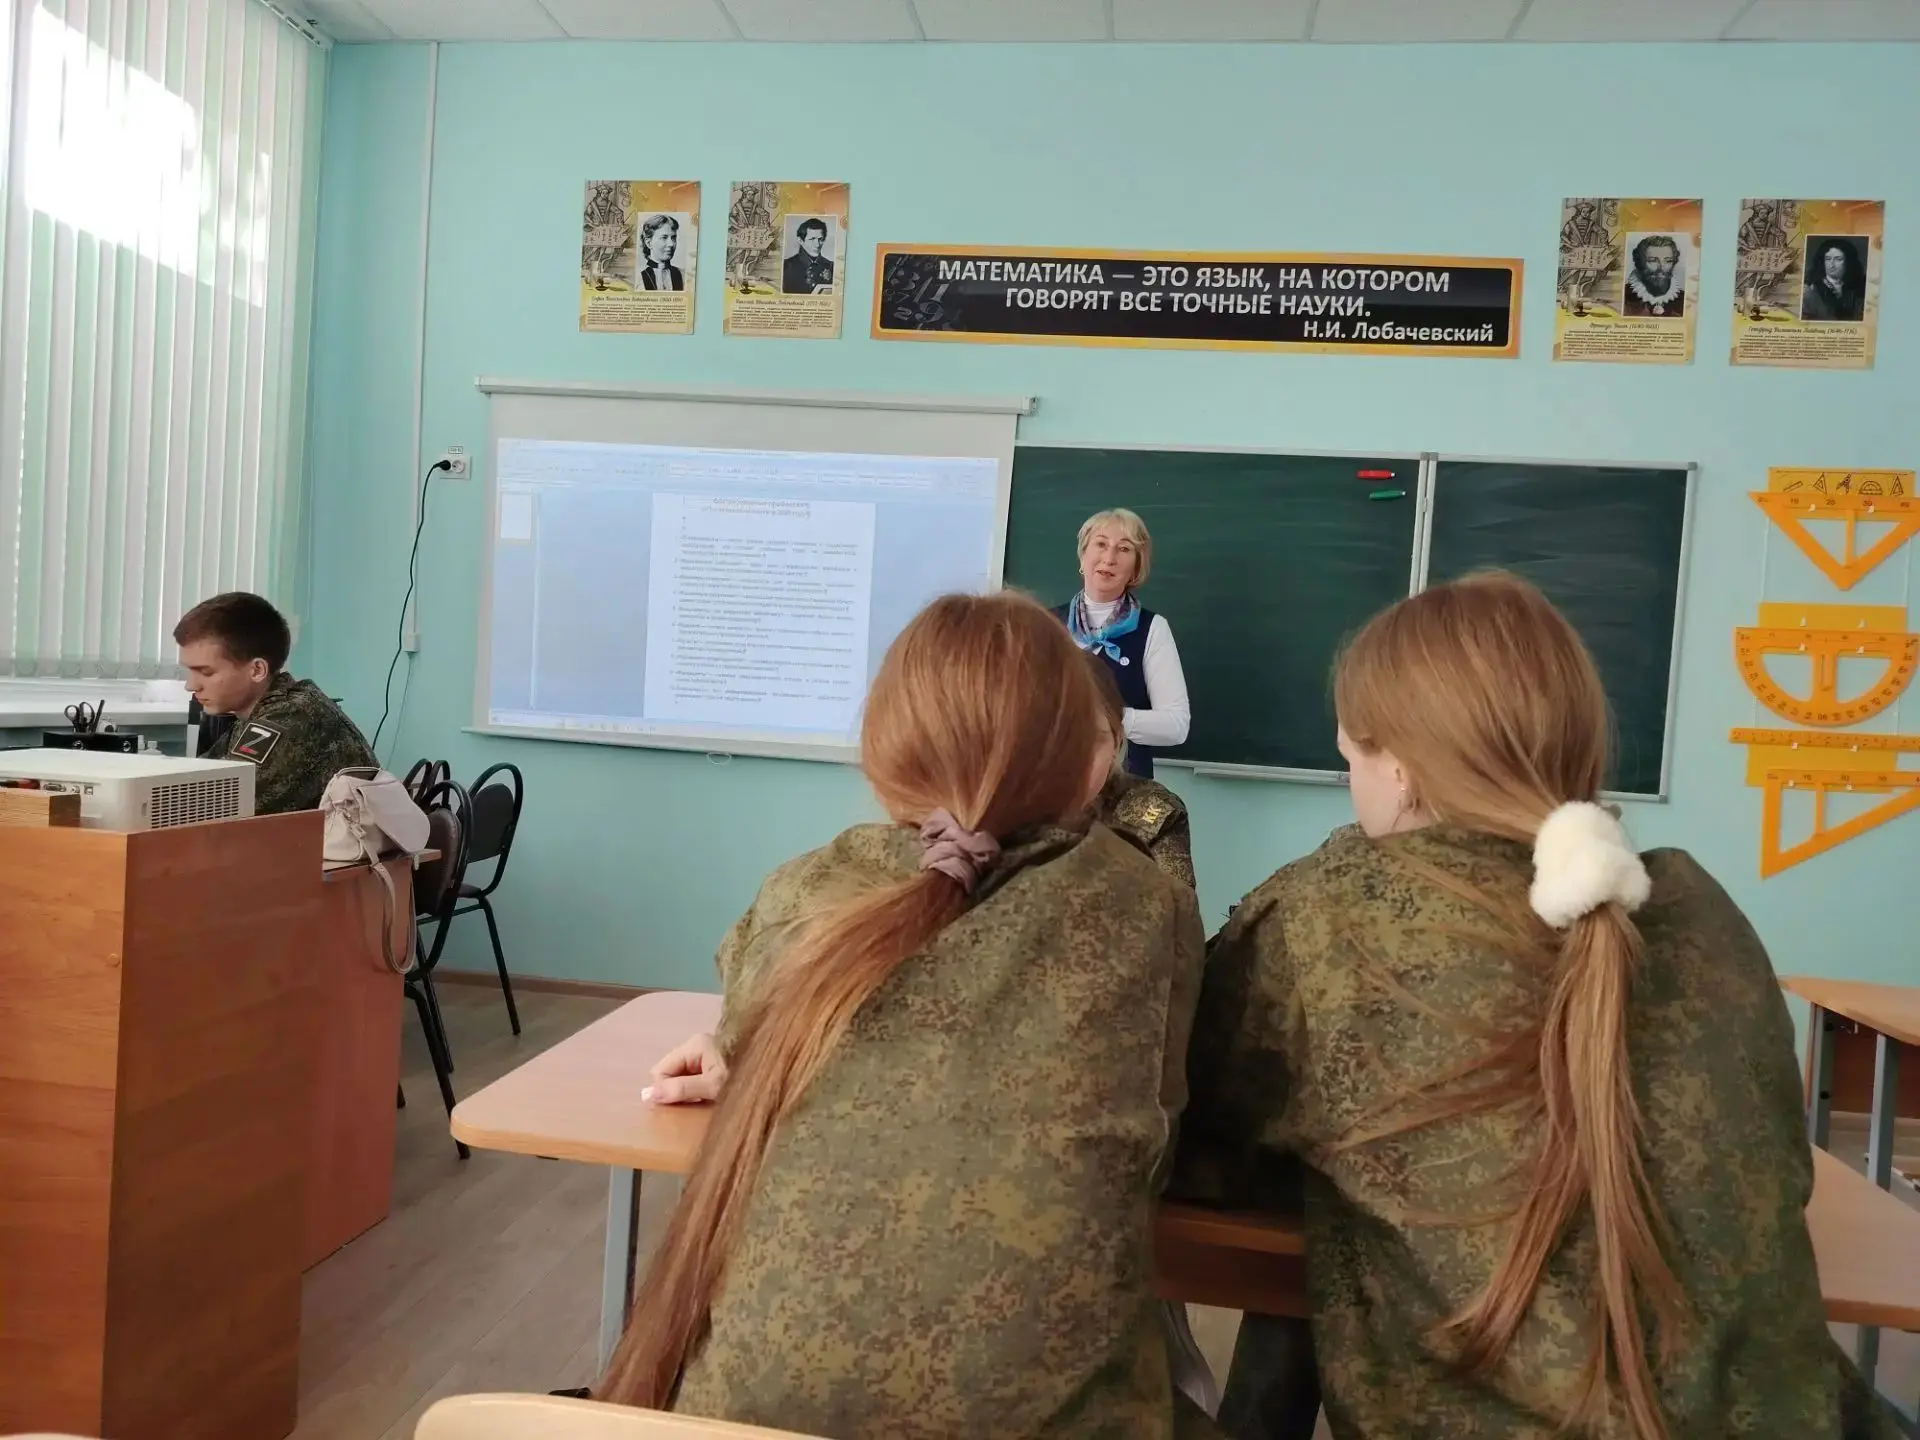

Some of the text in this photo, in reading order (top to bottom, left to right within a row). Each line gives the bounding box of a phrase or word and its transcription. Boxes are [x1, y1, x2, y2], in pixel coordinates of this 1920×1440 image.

[938, 260, 1105, 285] МАТЕМАТИКА
[1142, 265, 1189, 287] ЭТО
[1195, 267, 1271, 292] ЯЗЫК,
[1278, 268, 1314, 289] НА
[1321, 268, 1450, 293] КОТОРОМ
[1006, 287, 1371, 317] ГОВОРЯТ ВСЕ ТОЧНЫЕ НАУКИ.
[1303, 320, 1493, 342] Н.И. Лобачевский
[239, 726, 272, 755] Z
